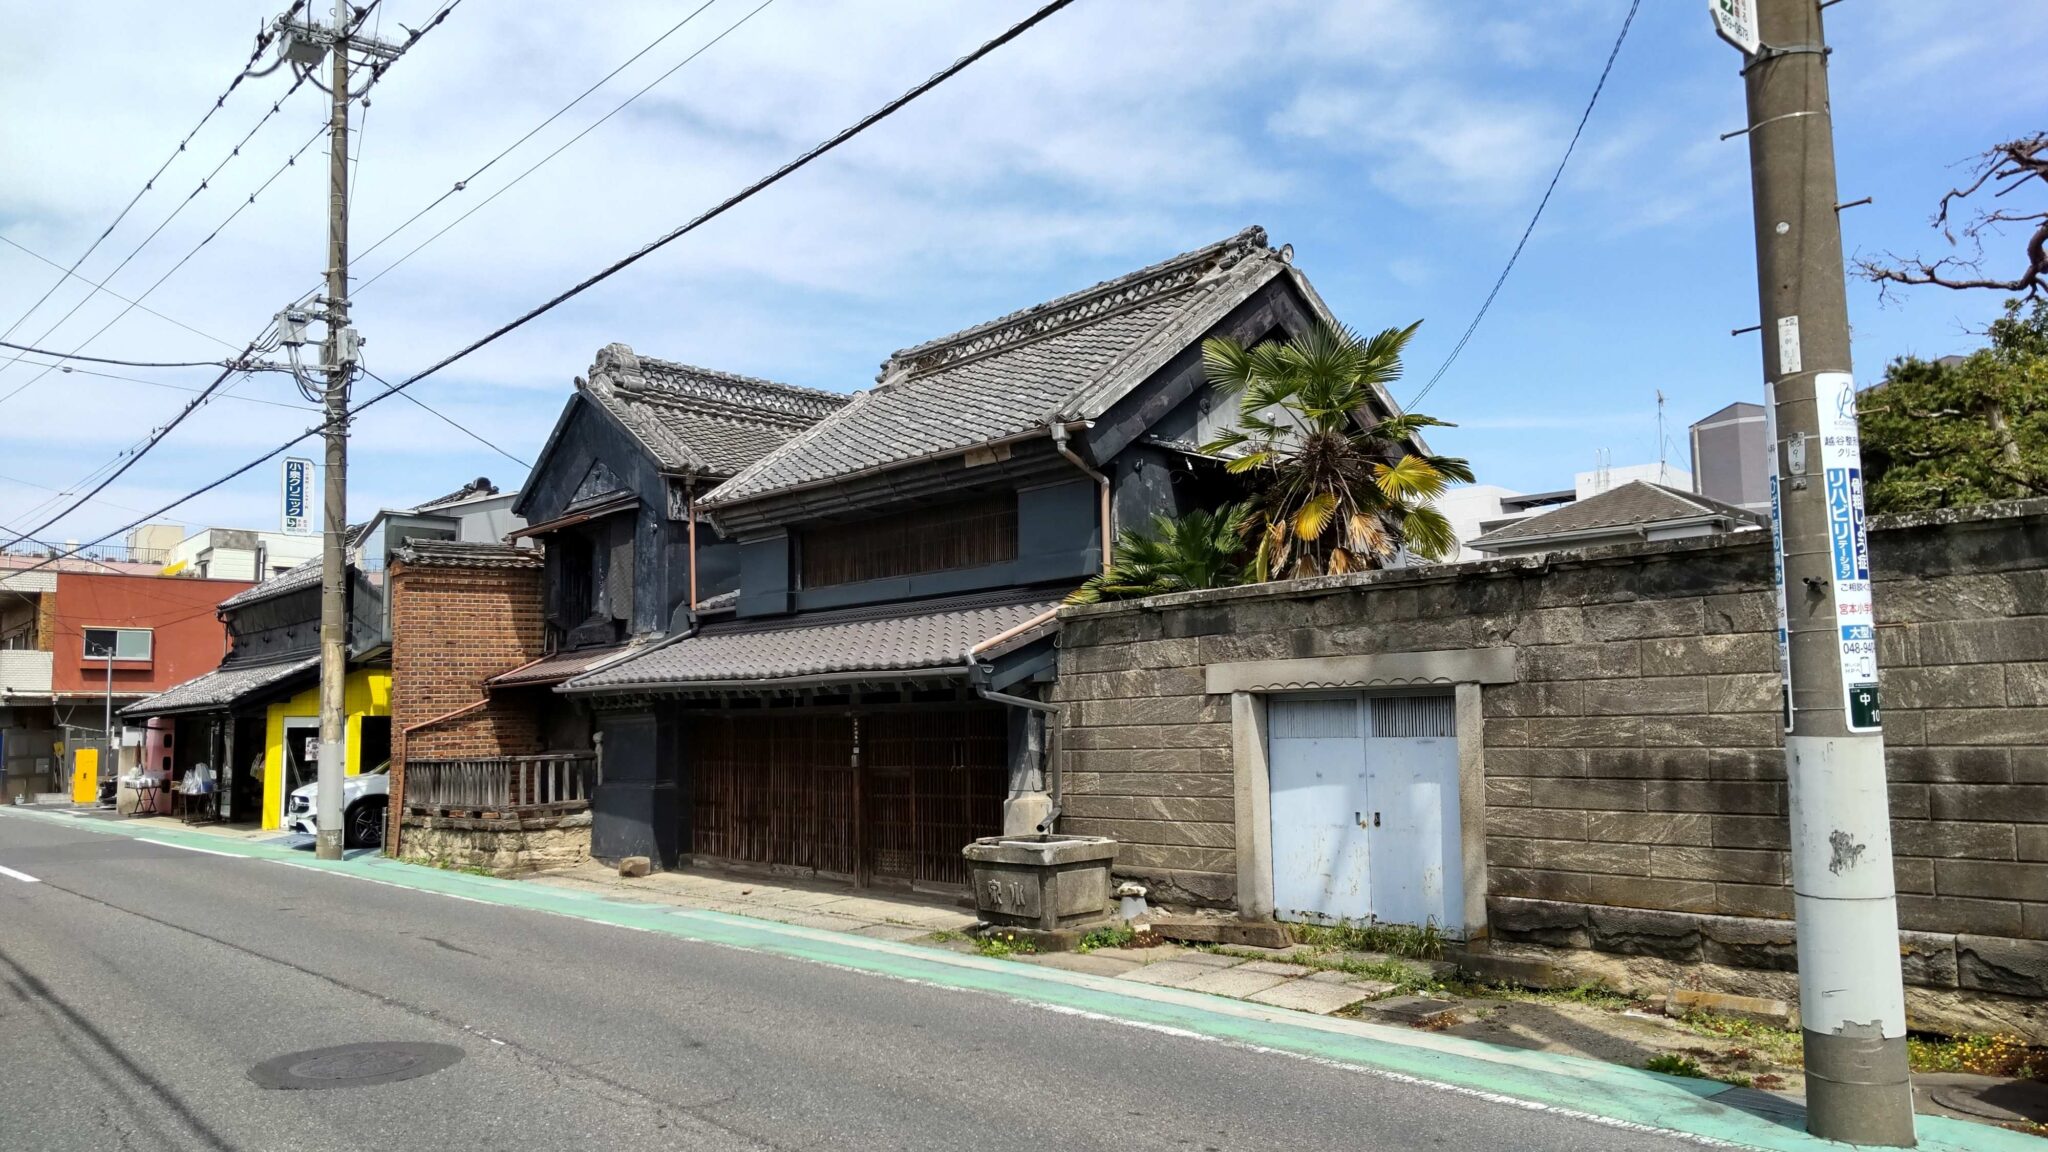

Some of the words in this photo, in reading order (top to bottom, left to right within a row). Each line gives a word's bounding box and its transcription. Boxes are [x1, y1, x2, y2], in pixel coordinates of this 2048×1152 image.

[288, 463, 302, 516] 小泉クリニック
[1829, 470, 1851, 579] リハビリテーション
